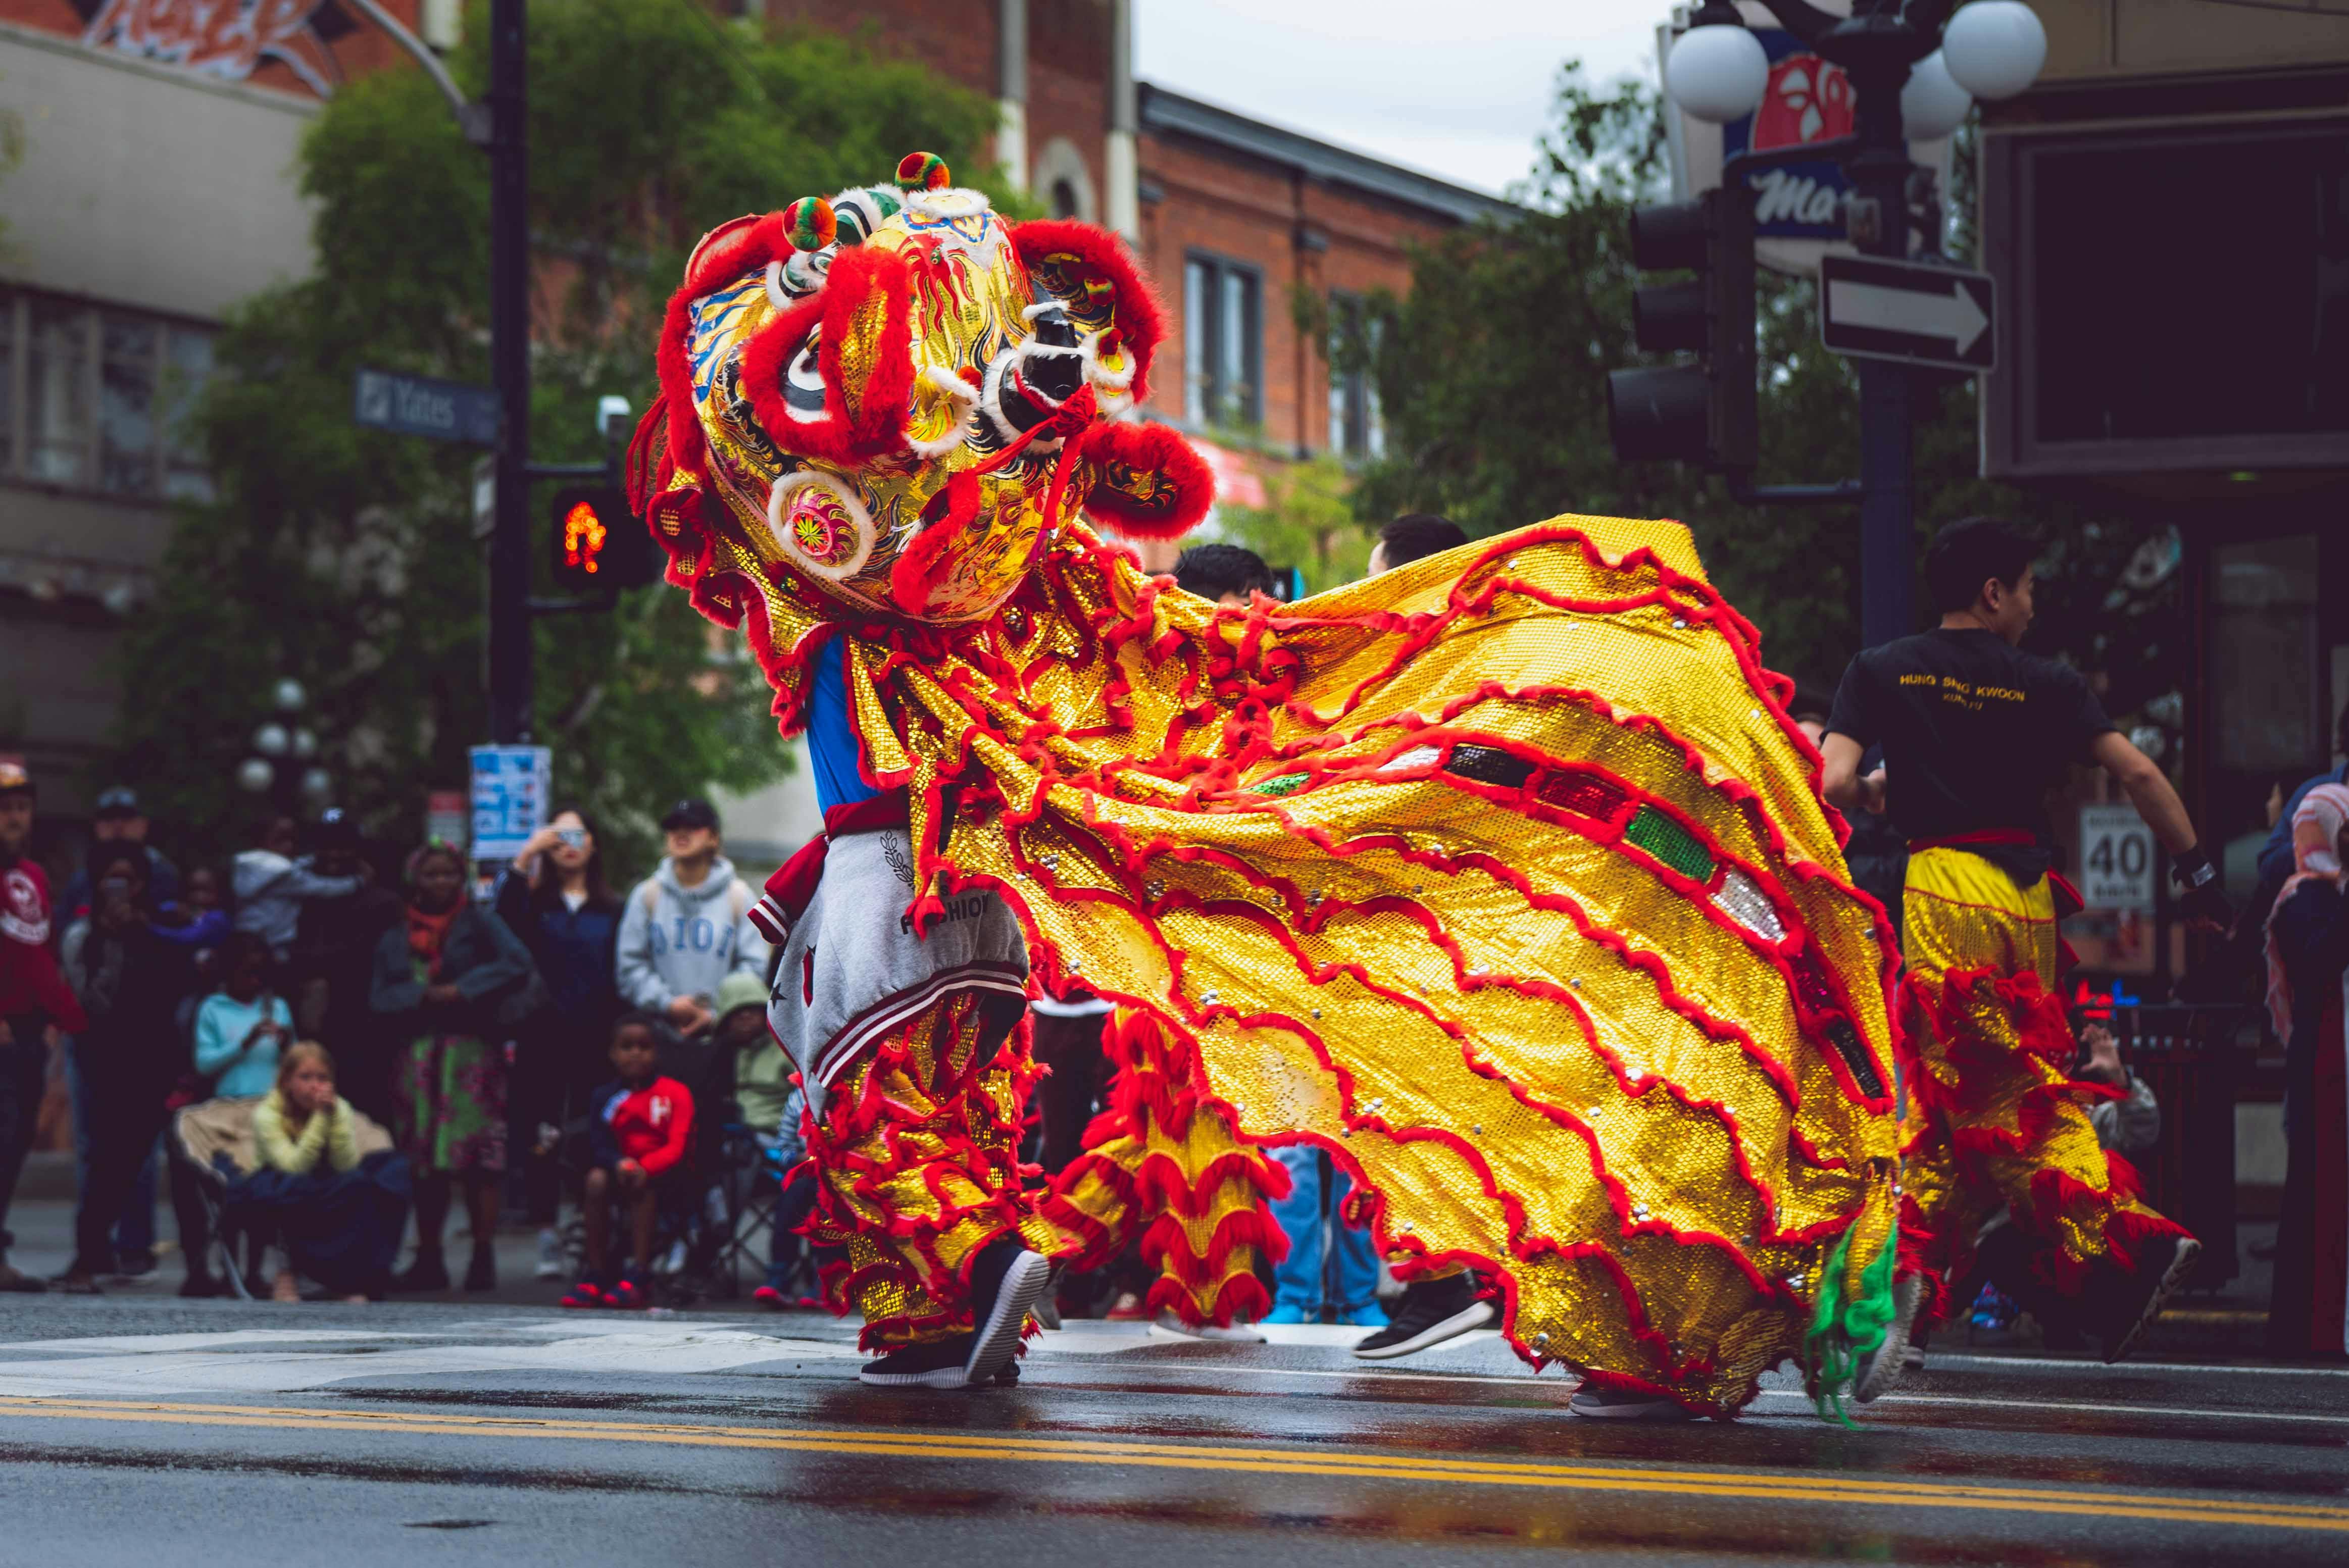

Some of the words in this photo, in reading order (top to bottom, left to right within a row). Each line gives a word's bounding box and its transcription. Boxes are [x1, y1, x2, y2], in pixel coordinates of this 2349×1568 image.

[395, 380, 454, 429] Yates
[1900, 674, 1937, 685] HUNG
[1942, 676, 1970, 694] SING
[1975, 686, 2025, 702] KWOON
[2089, 832, 2147, 881] 40
